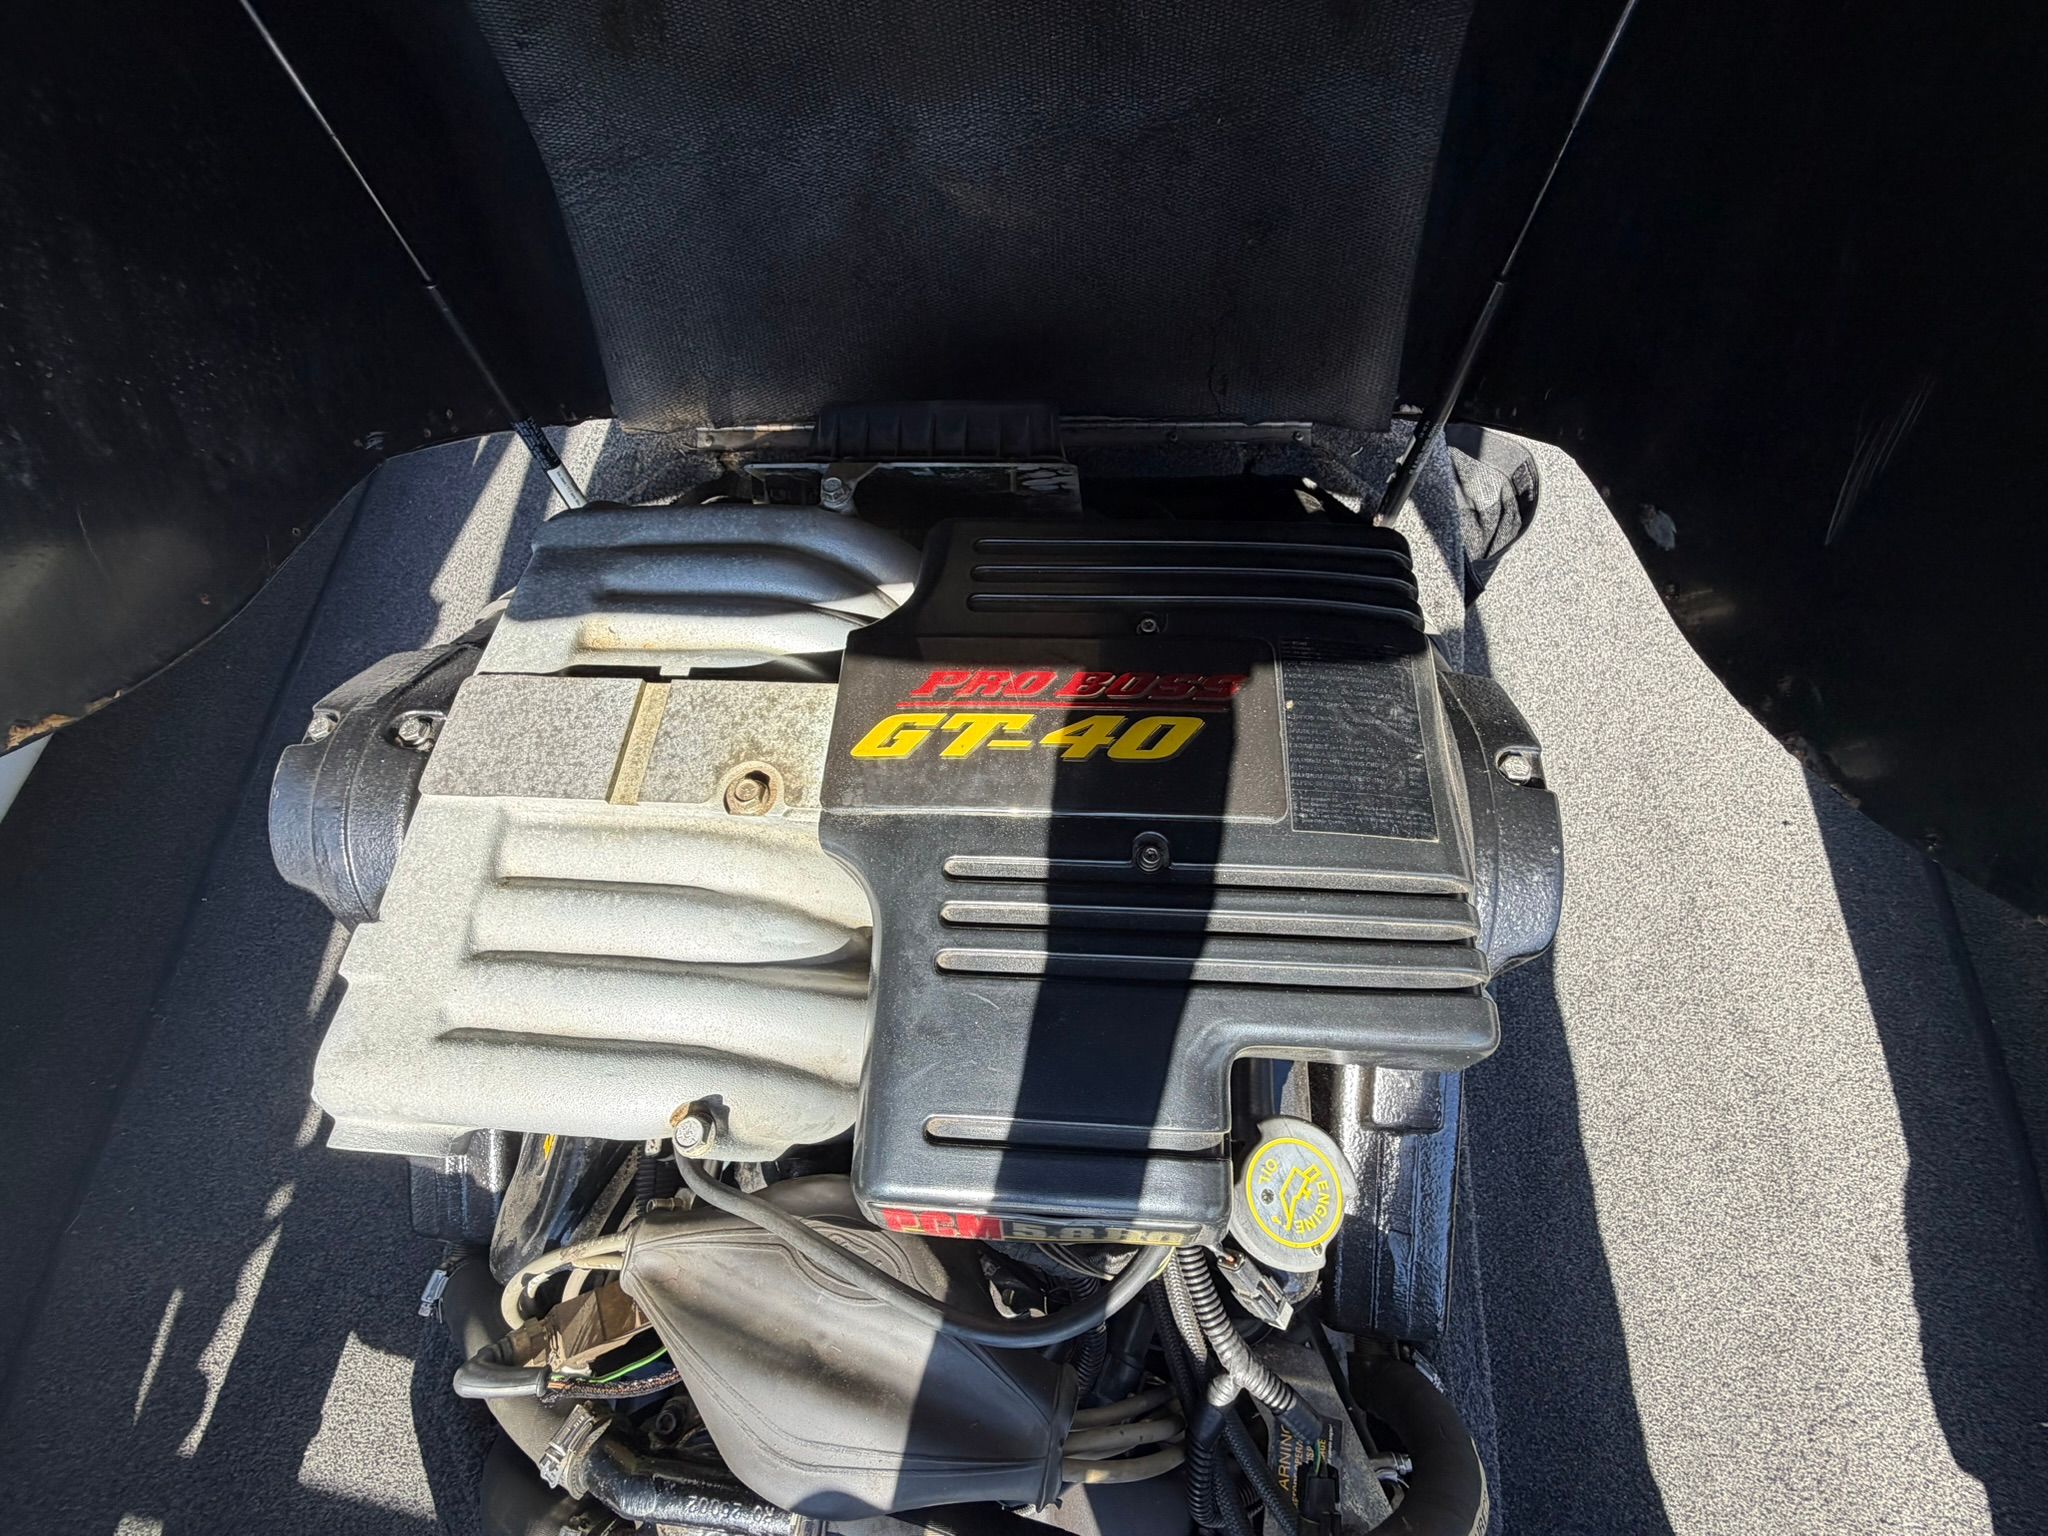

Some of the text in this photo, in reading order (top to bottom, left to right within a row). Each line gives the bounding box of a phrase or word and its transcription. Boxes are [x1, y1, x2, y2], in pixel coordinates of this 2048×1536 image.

[910, 670, 1249, 701] PRO BOSS
[850, 712, 1206, 763] GT-40
[1258, 1158, 1279, 1186] OIL
[881, 1207, 1003, 1240] PCM
[1293, 1180, 1330, 1234] ENGINE
